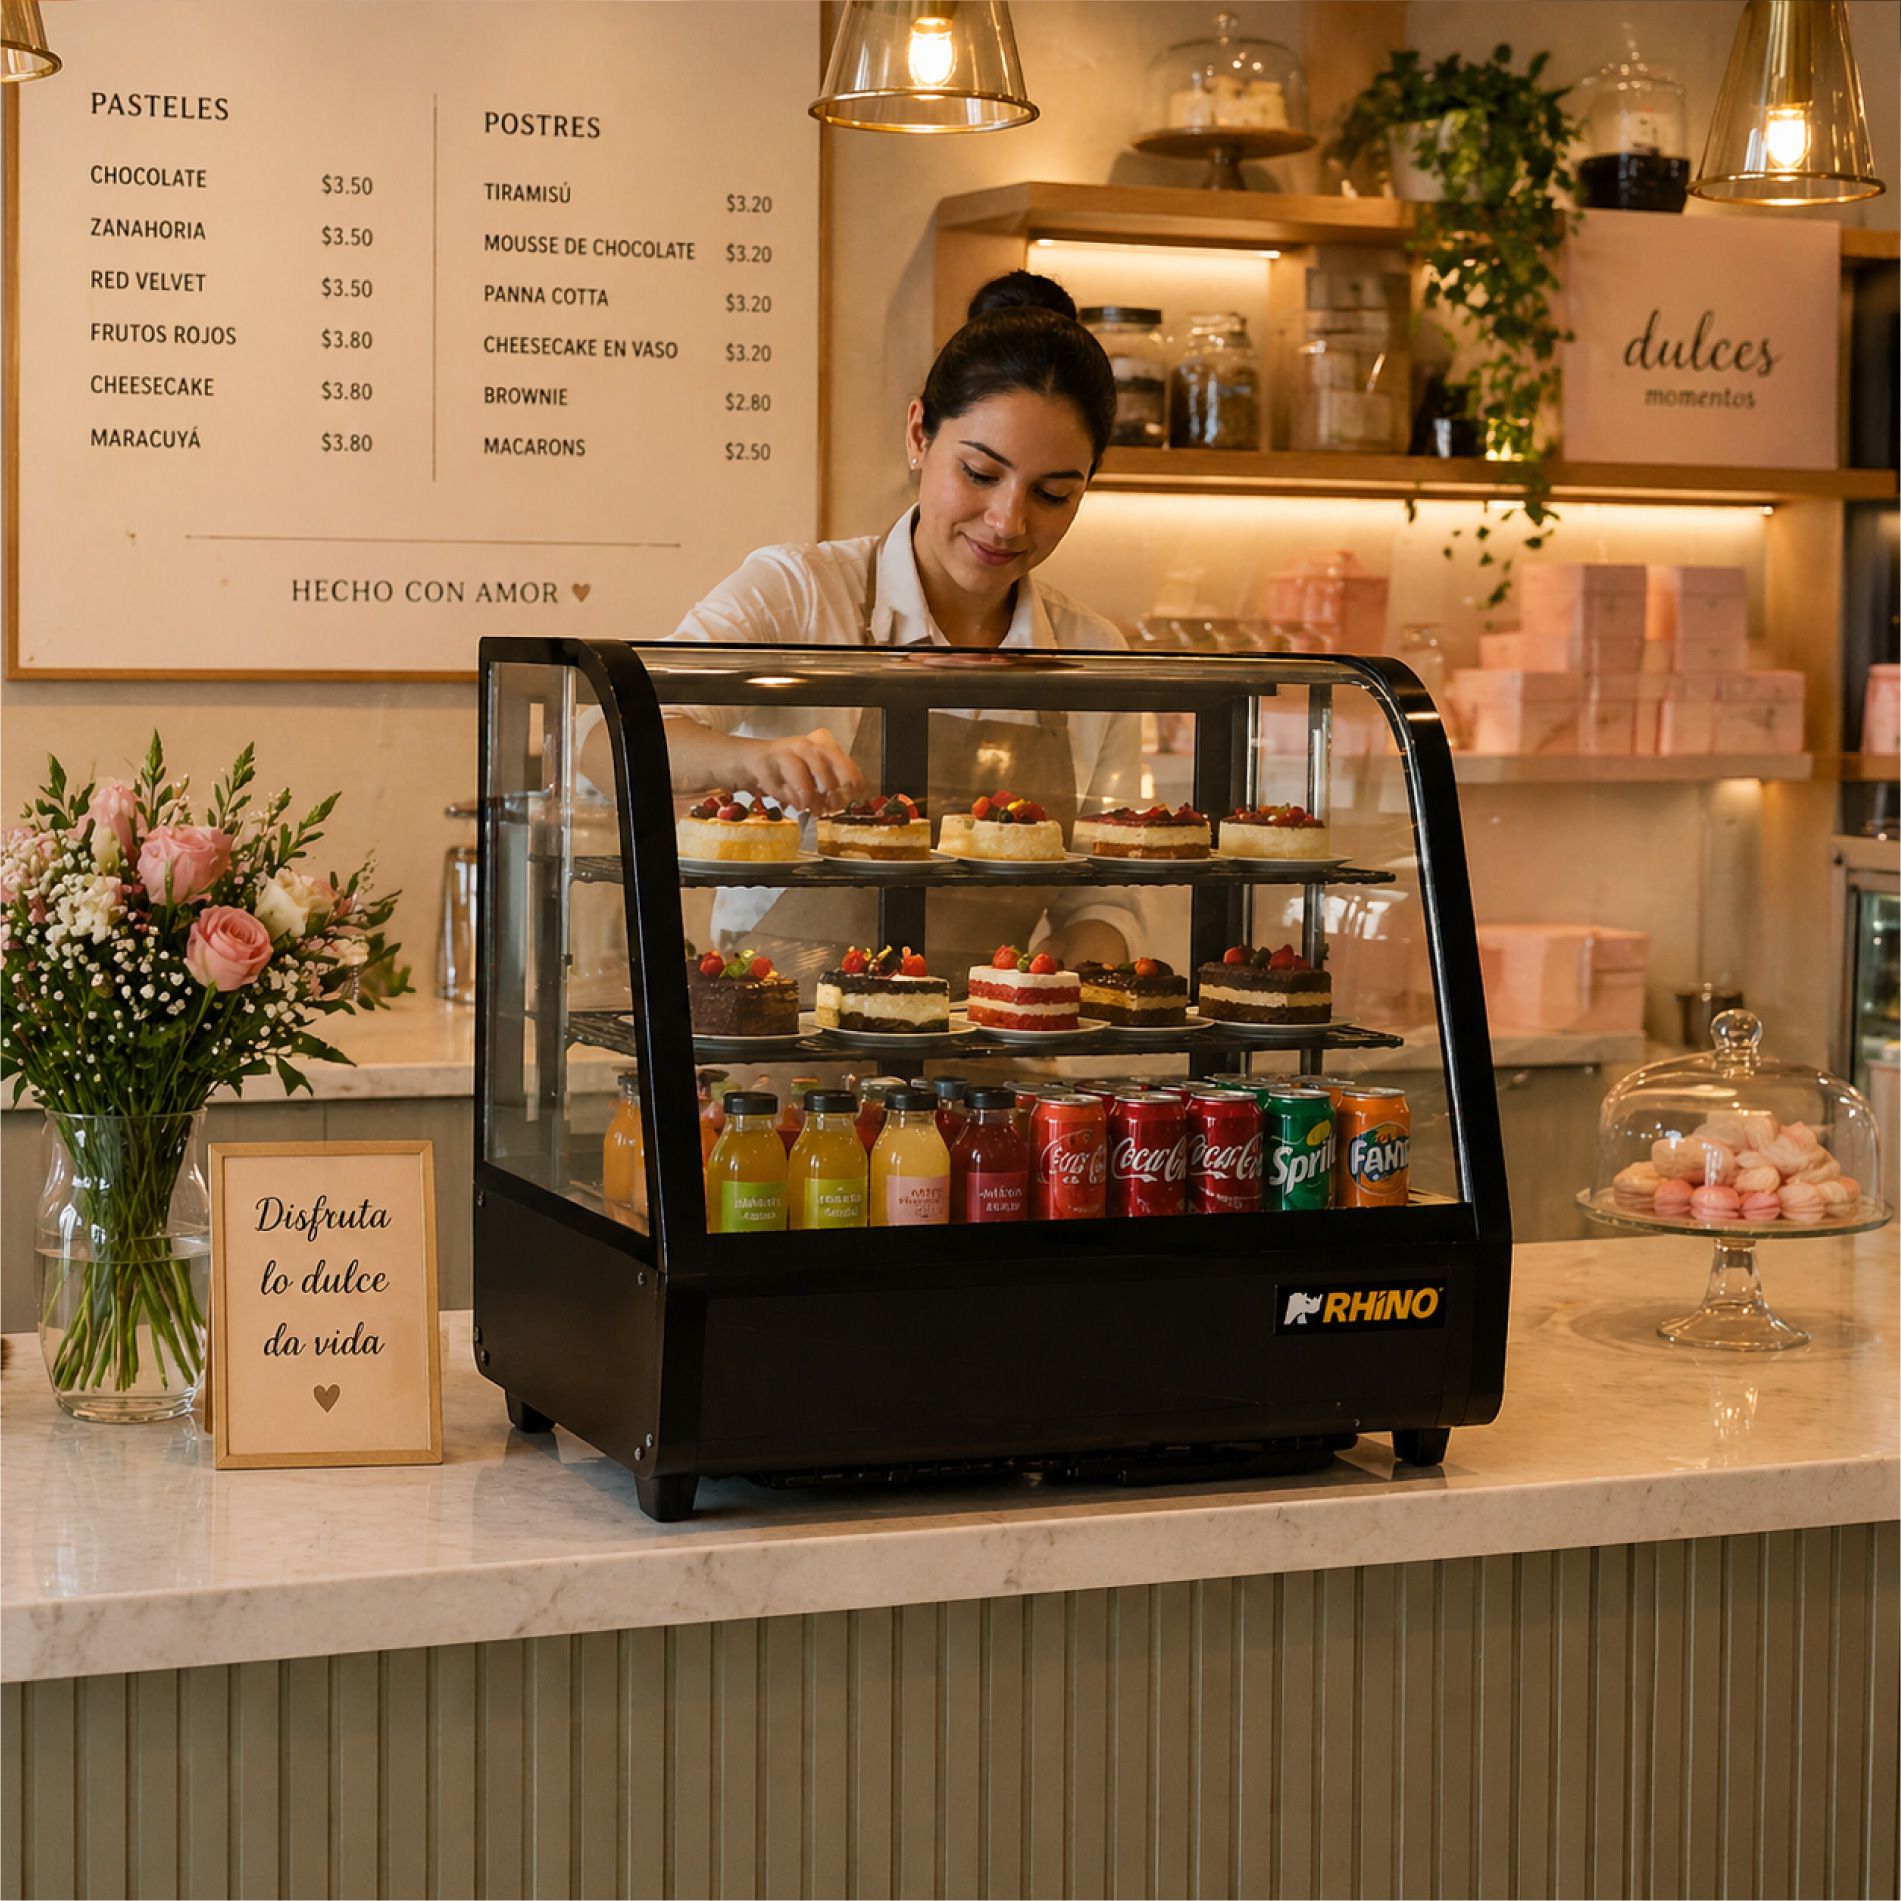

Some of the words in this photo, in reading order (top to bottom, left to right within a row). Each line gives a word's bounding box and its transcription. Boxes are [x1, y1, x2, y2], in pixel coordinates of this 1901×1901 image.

[90, 91, 229, 122] PASTELES
[484, 111, 601, 140] POSTRES
[90, 164, 208, 189] CHOCOLATE
[321, 173, 374, 196] $3.50
[483, 181, 571, 206] TIRAMISÚ
[725, 193, 773, 214] $3.20
[90, 216, 206, 241] ZANAHORIA
[321, 225, 374, 247] $3.50
[484, 233, 559, 255] MOUSSE
[564, 236, 588, 256] DE
[592, 238, 696, 261] CHOCOLATE
[725, 242, 773, 264] $3.20
[90, 269, 130, 290] RED
[134, 271, 207, 293] VELVET
[321, 276, 374, 299] $3.50
[484, 284, 547, 304] PANNA
[551, 286, 609, 307] COTTA
[725, 292, 773, 314] $3.20
[90, 322, 168, 344] FRUTOS
[173, 325, 237, 347] ROJOS
[321, 328, 373, 350] $3.80
[1623, 308, 1782, 378] dulces
[483, 334, 598, 357] CHEESECAKE
[603, 339, 627, 358] EN
[631, 340, 679, 360] VASO
[725, 342, 772, 363] $3.20
[90, 374, 215, 397] CHEESECAKE
[321, 380, 373, 401] $3.80
[483, 386, 568, 407] BROWNIE
[725, 392, 771, 412] $2.80
[1644, 388, 1756, 410] momentos
[90, 425, 202, 449] MARACUYÁ
[321, 431, 373, 453] $3.80
[483, 436, 586, 458] MACARONS
[725, 441, 771, 462] $2.50
[292, 578, 394, 603] HECHO
[404, 580, 465, 603] CON
[475, 581, 559, 604] AMOR
[254, 1194, 392, 1243] Disfruta
[260, 1259, 294, 1296] lo
[301, 1258, 391, 1295] dulce
[314, 1321, 386, 1357] vida
